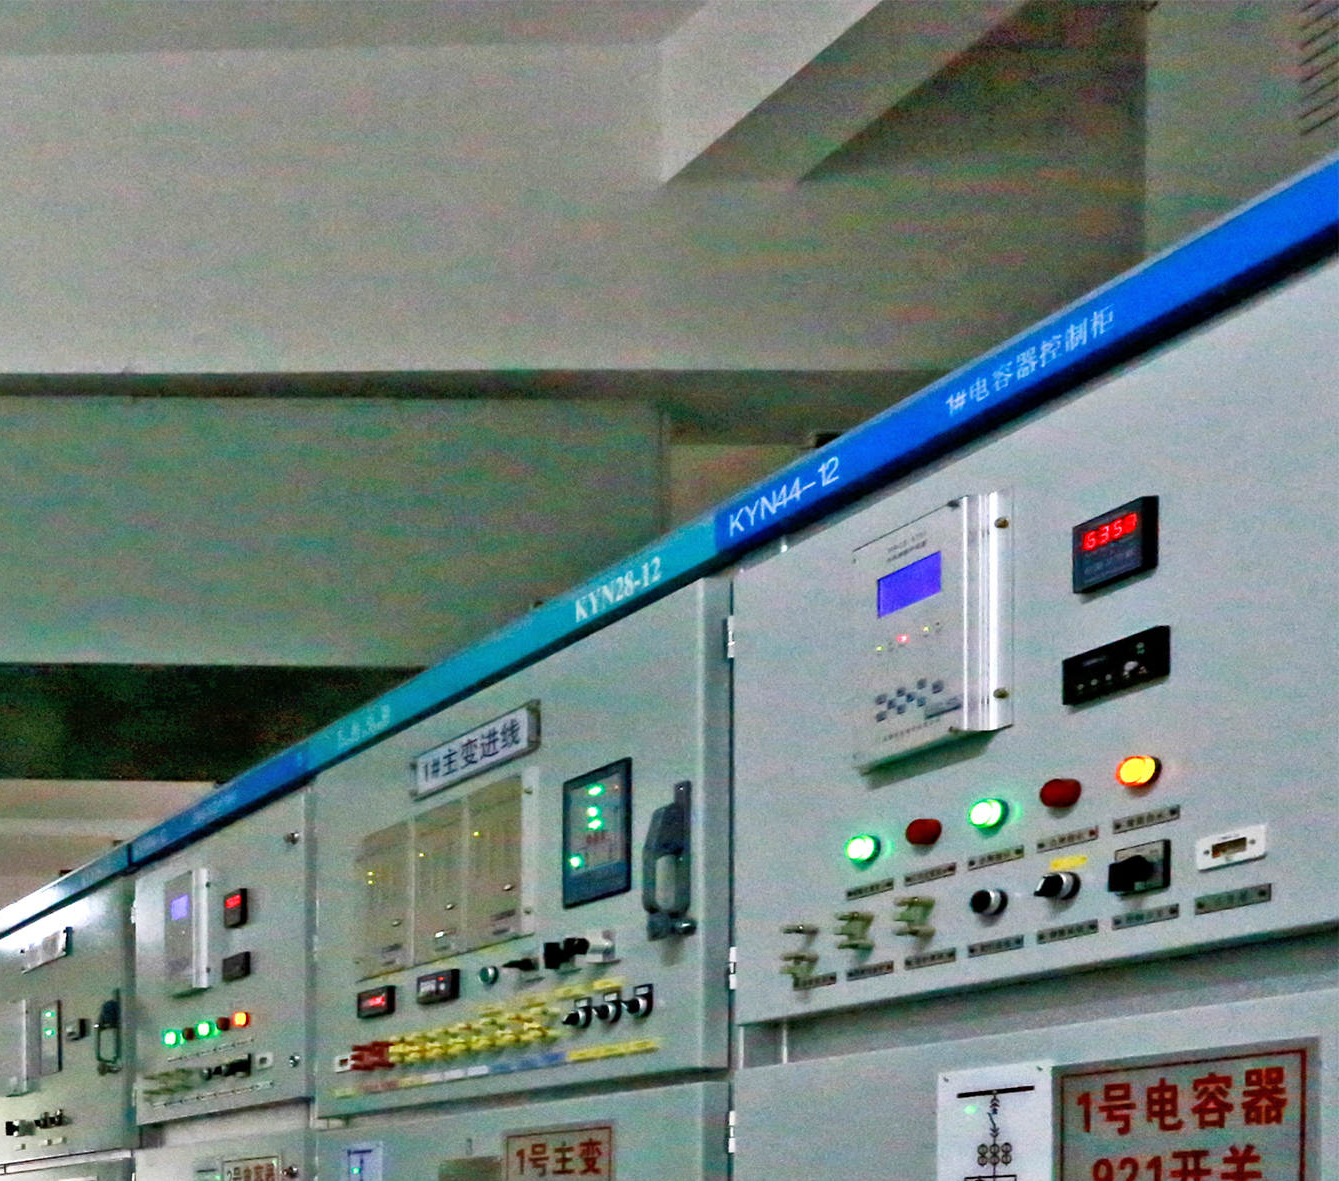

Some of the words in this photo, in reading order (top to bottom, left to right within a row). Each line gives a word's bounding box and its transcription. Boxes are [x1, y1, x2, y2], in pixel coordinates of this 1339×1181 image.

[946, 303, 1114, 416] 1#电容器控制柜
[730, 456, 839, 537] KYN44-12
[575, 556, 663, 623] KYN28-12
[424, 719, 521, 782] 1#主变进线
[1076, 1066, 1289, 1135] 1号电容器
[516, 1138, 603, 1177] 1号主变
